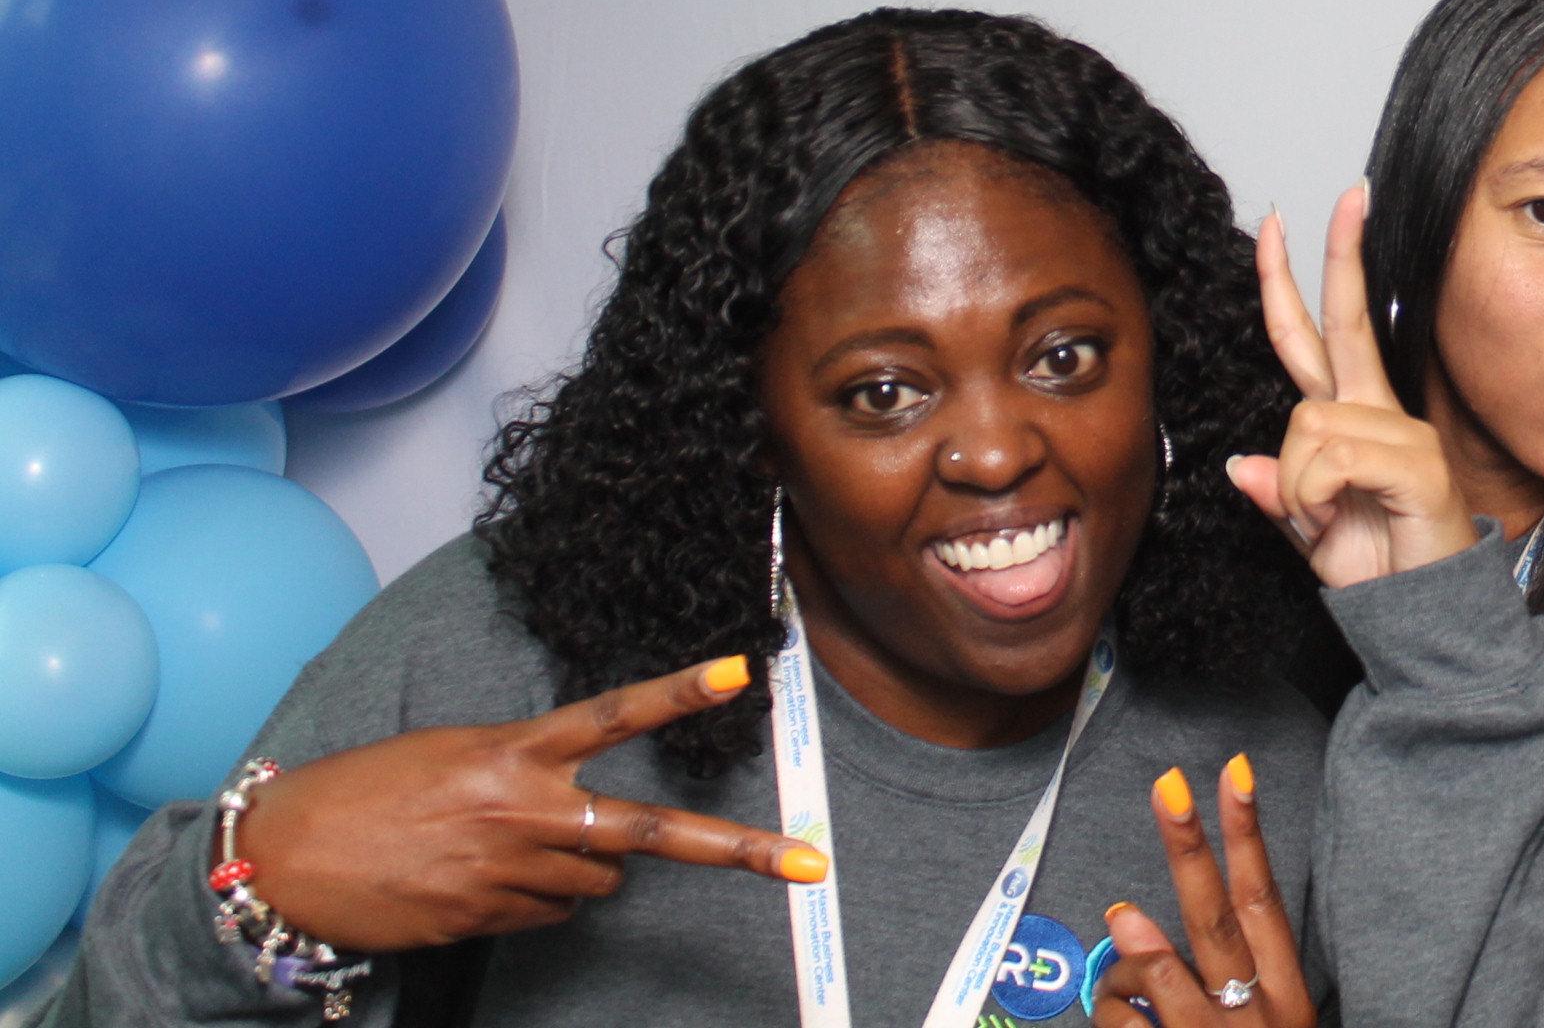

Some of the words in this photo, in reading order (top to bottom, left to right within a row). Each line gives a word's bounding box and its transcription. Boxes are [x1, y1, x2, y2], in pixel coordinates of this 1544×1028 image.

[784, 666, 797, 726] Innovation
[791, 729, 801, 768] Center
[791, 654, 803, 691] Mason
[797, 695, 810, 746] Business
[818, 889, 829, 927] Mason
[999, 903, 1017, 939] Mason
[807, 900, 821, 963] Innovation
[814, 966, 825, 1006] Center
[822, 931, 834, 983] Business
[973, 912, 1003, 967] Innovation
[955, 970, 977, 1007] Center
[974, 942, 1001, 990] Business
